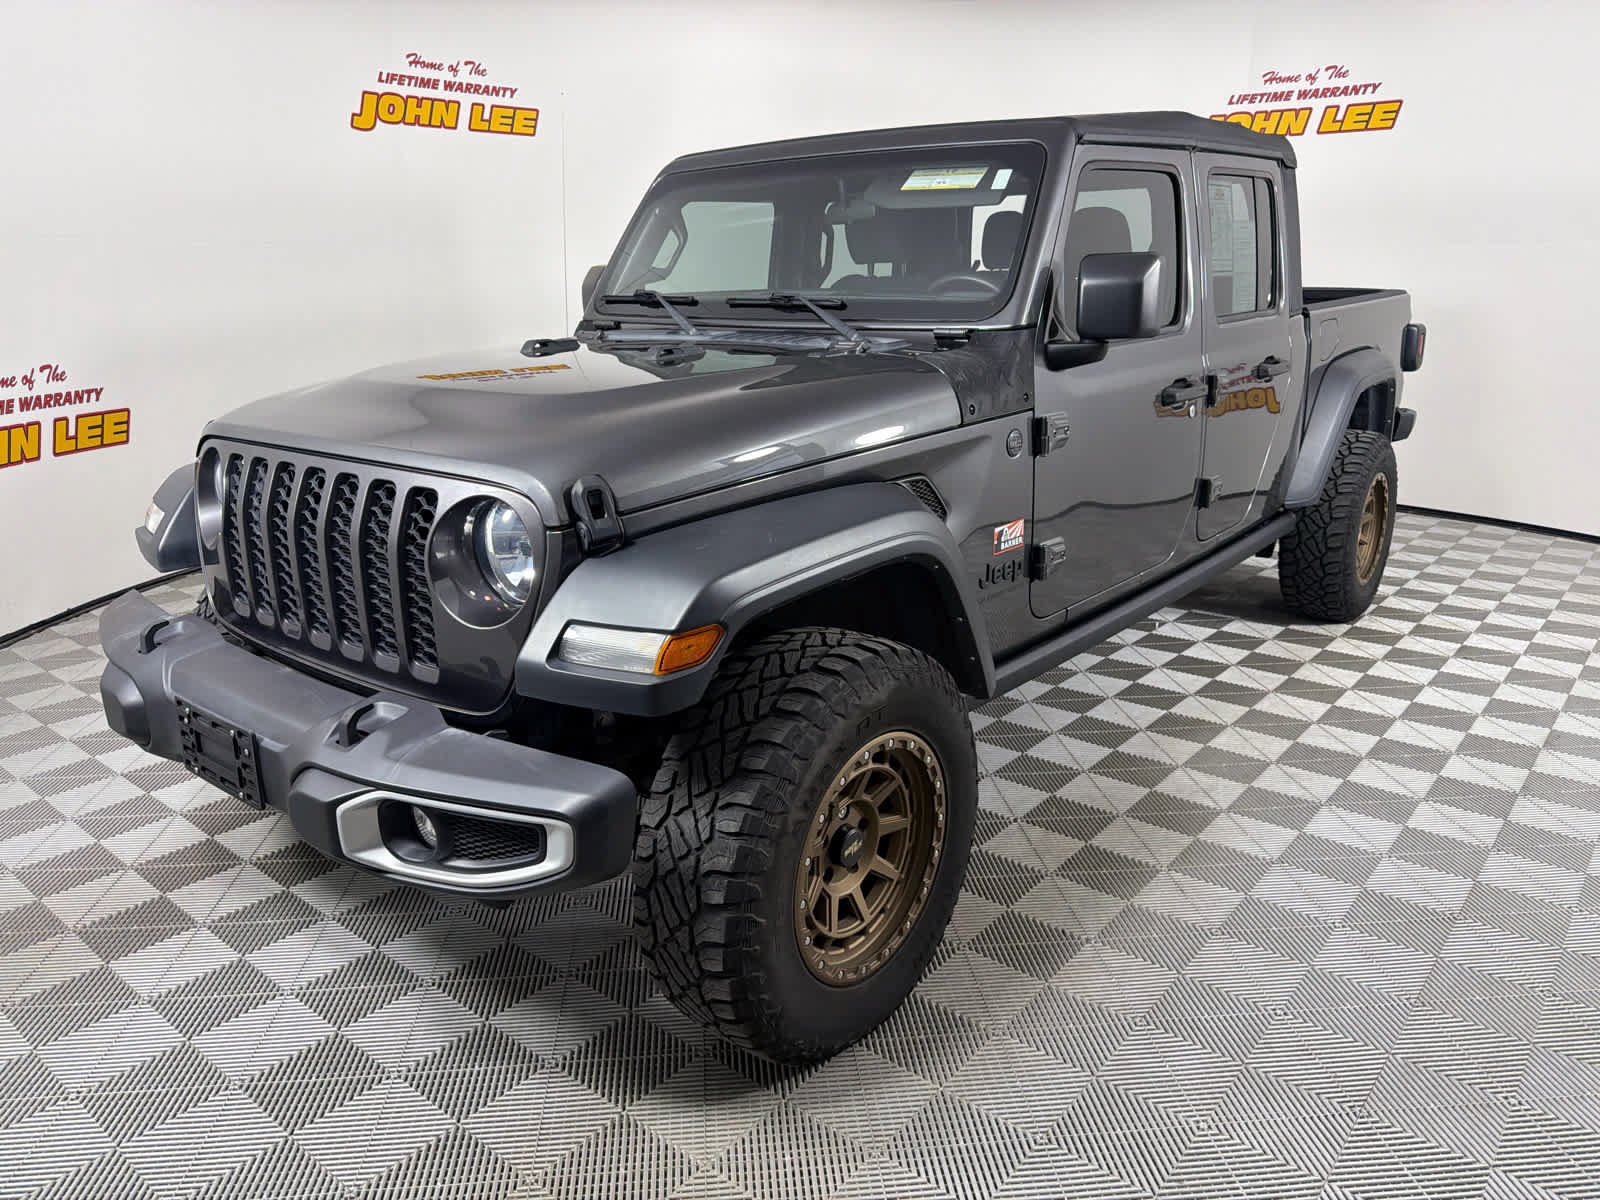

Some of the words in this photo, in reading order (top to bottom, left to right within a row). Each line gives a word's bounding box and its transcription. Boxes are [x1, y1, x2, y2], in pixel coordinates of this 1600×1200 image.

[405, 53, 444, 72] Home
[447, 58, 460, 77] of
[464, 60, 488, 77] The
[1262, 70, 1301, 86] Home
[1305, 68, 1320, 86] of
[1325, 64, 1350, 81] The
[377, 71, 440, 91] LIFETIME
[443, 80, 518, 99] WARRANTY
[1227, 90, 1294, 105] LIFETIME
[1297, 82, 1382, 101] WARRANTY
[350, 90, 460, 132] JOHN
[468, 102, 539, 136] LEE
[1209, 107, 1313, 136] HN
[1316, 99, 1403, 135] LEE
[21, 367, 35, 391] of
[39, 363, 68, 384] The
[18, 387, 104, 413] WARRANTY
[53, 407, 131, 457] LEE
[978, 559, 1023, 590] Jeep
